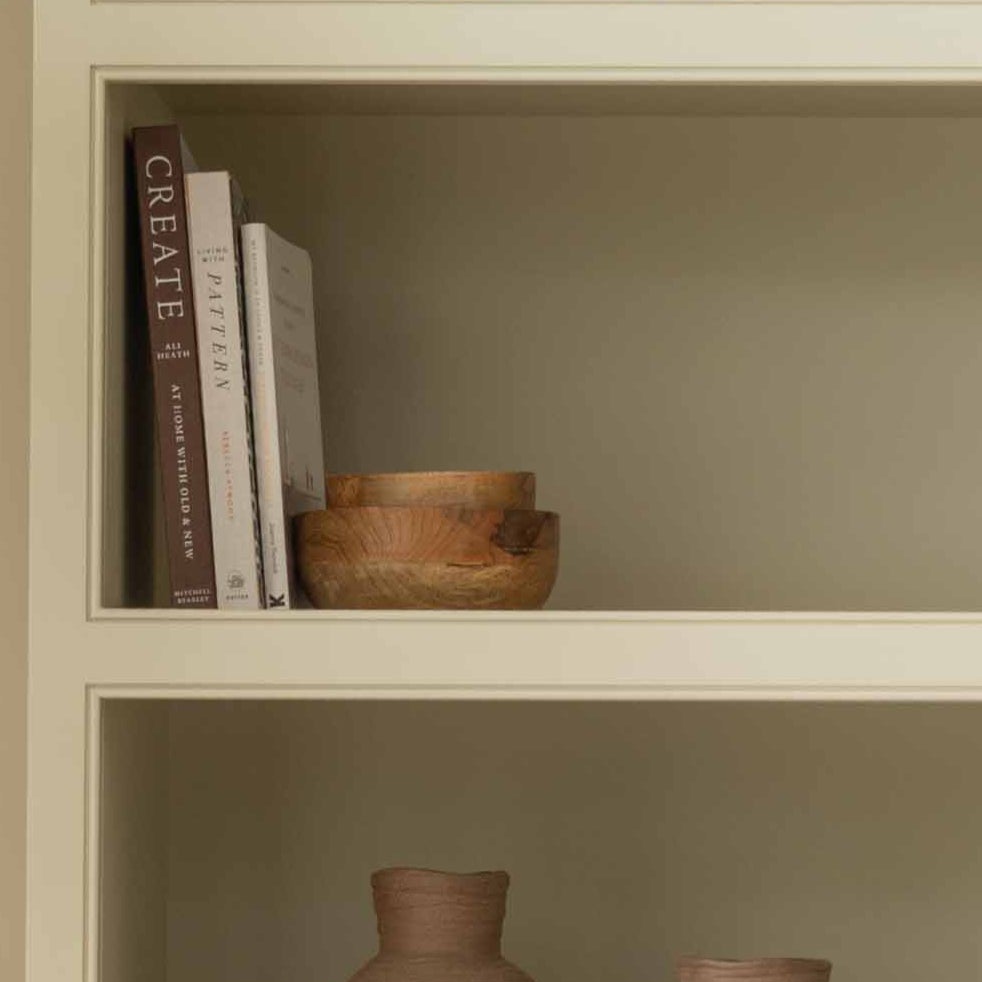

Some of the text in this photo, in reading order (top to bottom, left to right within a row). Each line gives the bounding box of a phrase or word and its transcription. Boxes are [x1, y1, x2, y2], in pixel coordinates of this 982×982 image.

[145, 155, 184, 320] CREATE
[165, 342, 181, 350] ALI
[207, 272, 230, 390] PATTERN
[157, 350, 190, 360] HEATH
[171, 384, 182, 401] AT
[173, 405, 185, 442] HOME
[176, 446, 188, 484] WITH
[179, 486, 191, 514] OLD
[184, 530, 194, 560] NEW
